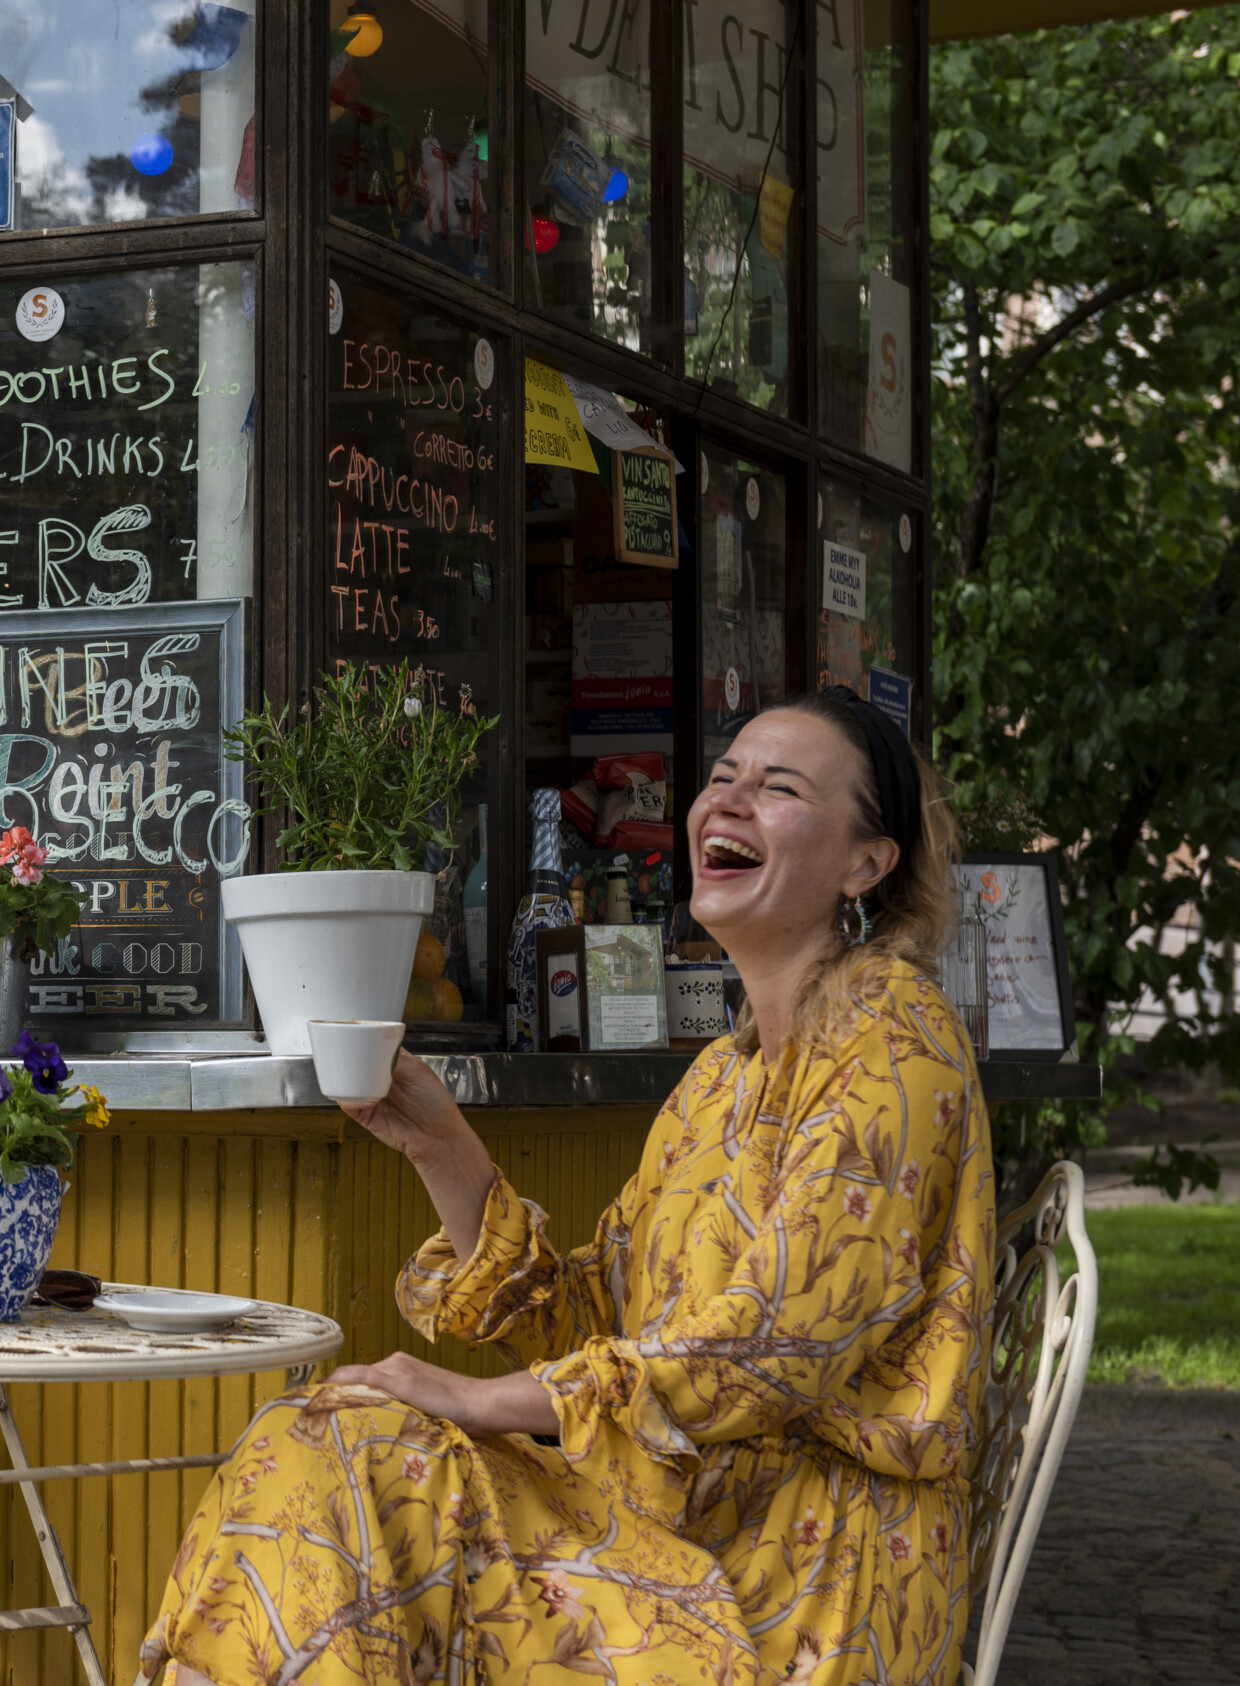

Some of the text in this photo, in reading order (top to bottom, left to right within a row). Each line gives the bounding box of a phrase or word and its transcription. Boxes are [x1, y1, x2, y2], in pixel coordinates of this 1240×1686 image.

[31, 294, 49, 319] S
[343, 339, 466, 414] ESPRESSO
[10, 422, 164, 484] DRINKS
[414, 431, 474, 472] CORRETTO
[621, 455, 671, 489] VIN SANTO
[328, 444, 459, 534] CAPPUCCINO
[623, 511, 658, 529] AFFOGATO
[335, 500, 411, 579] LATTE
[830, 548, 861, 571] EMME MYY
[828, 568, 861, 592] ALKOHOLIA
[331, 584, 401, 643] TEAS
[832, 588, 847, 606] ALLE
[18, 652, 201, 738] Beer
[980, 871, 1002, 903] S
[92, 943, 203, 975] GOOD
[28, 984, 209, 1016] EER
